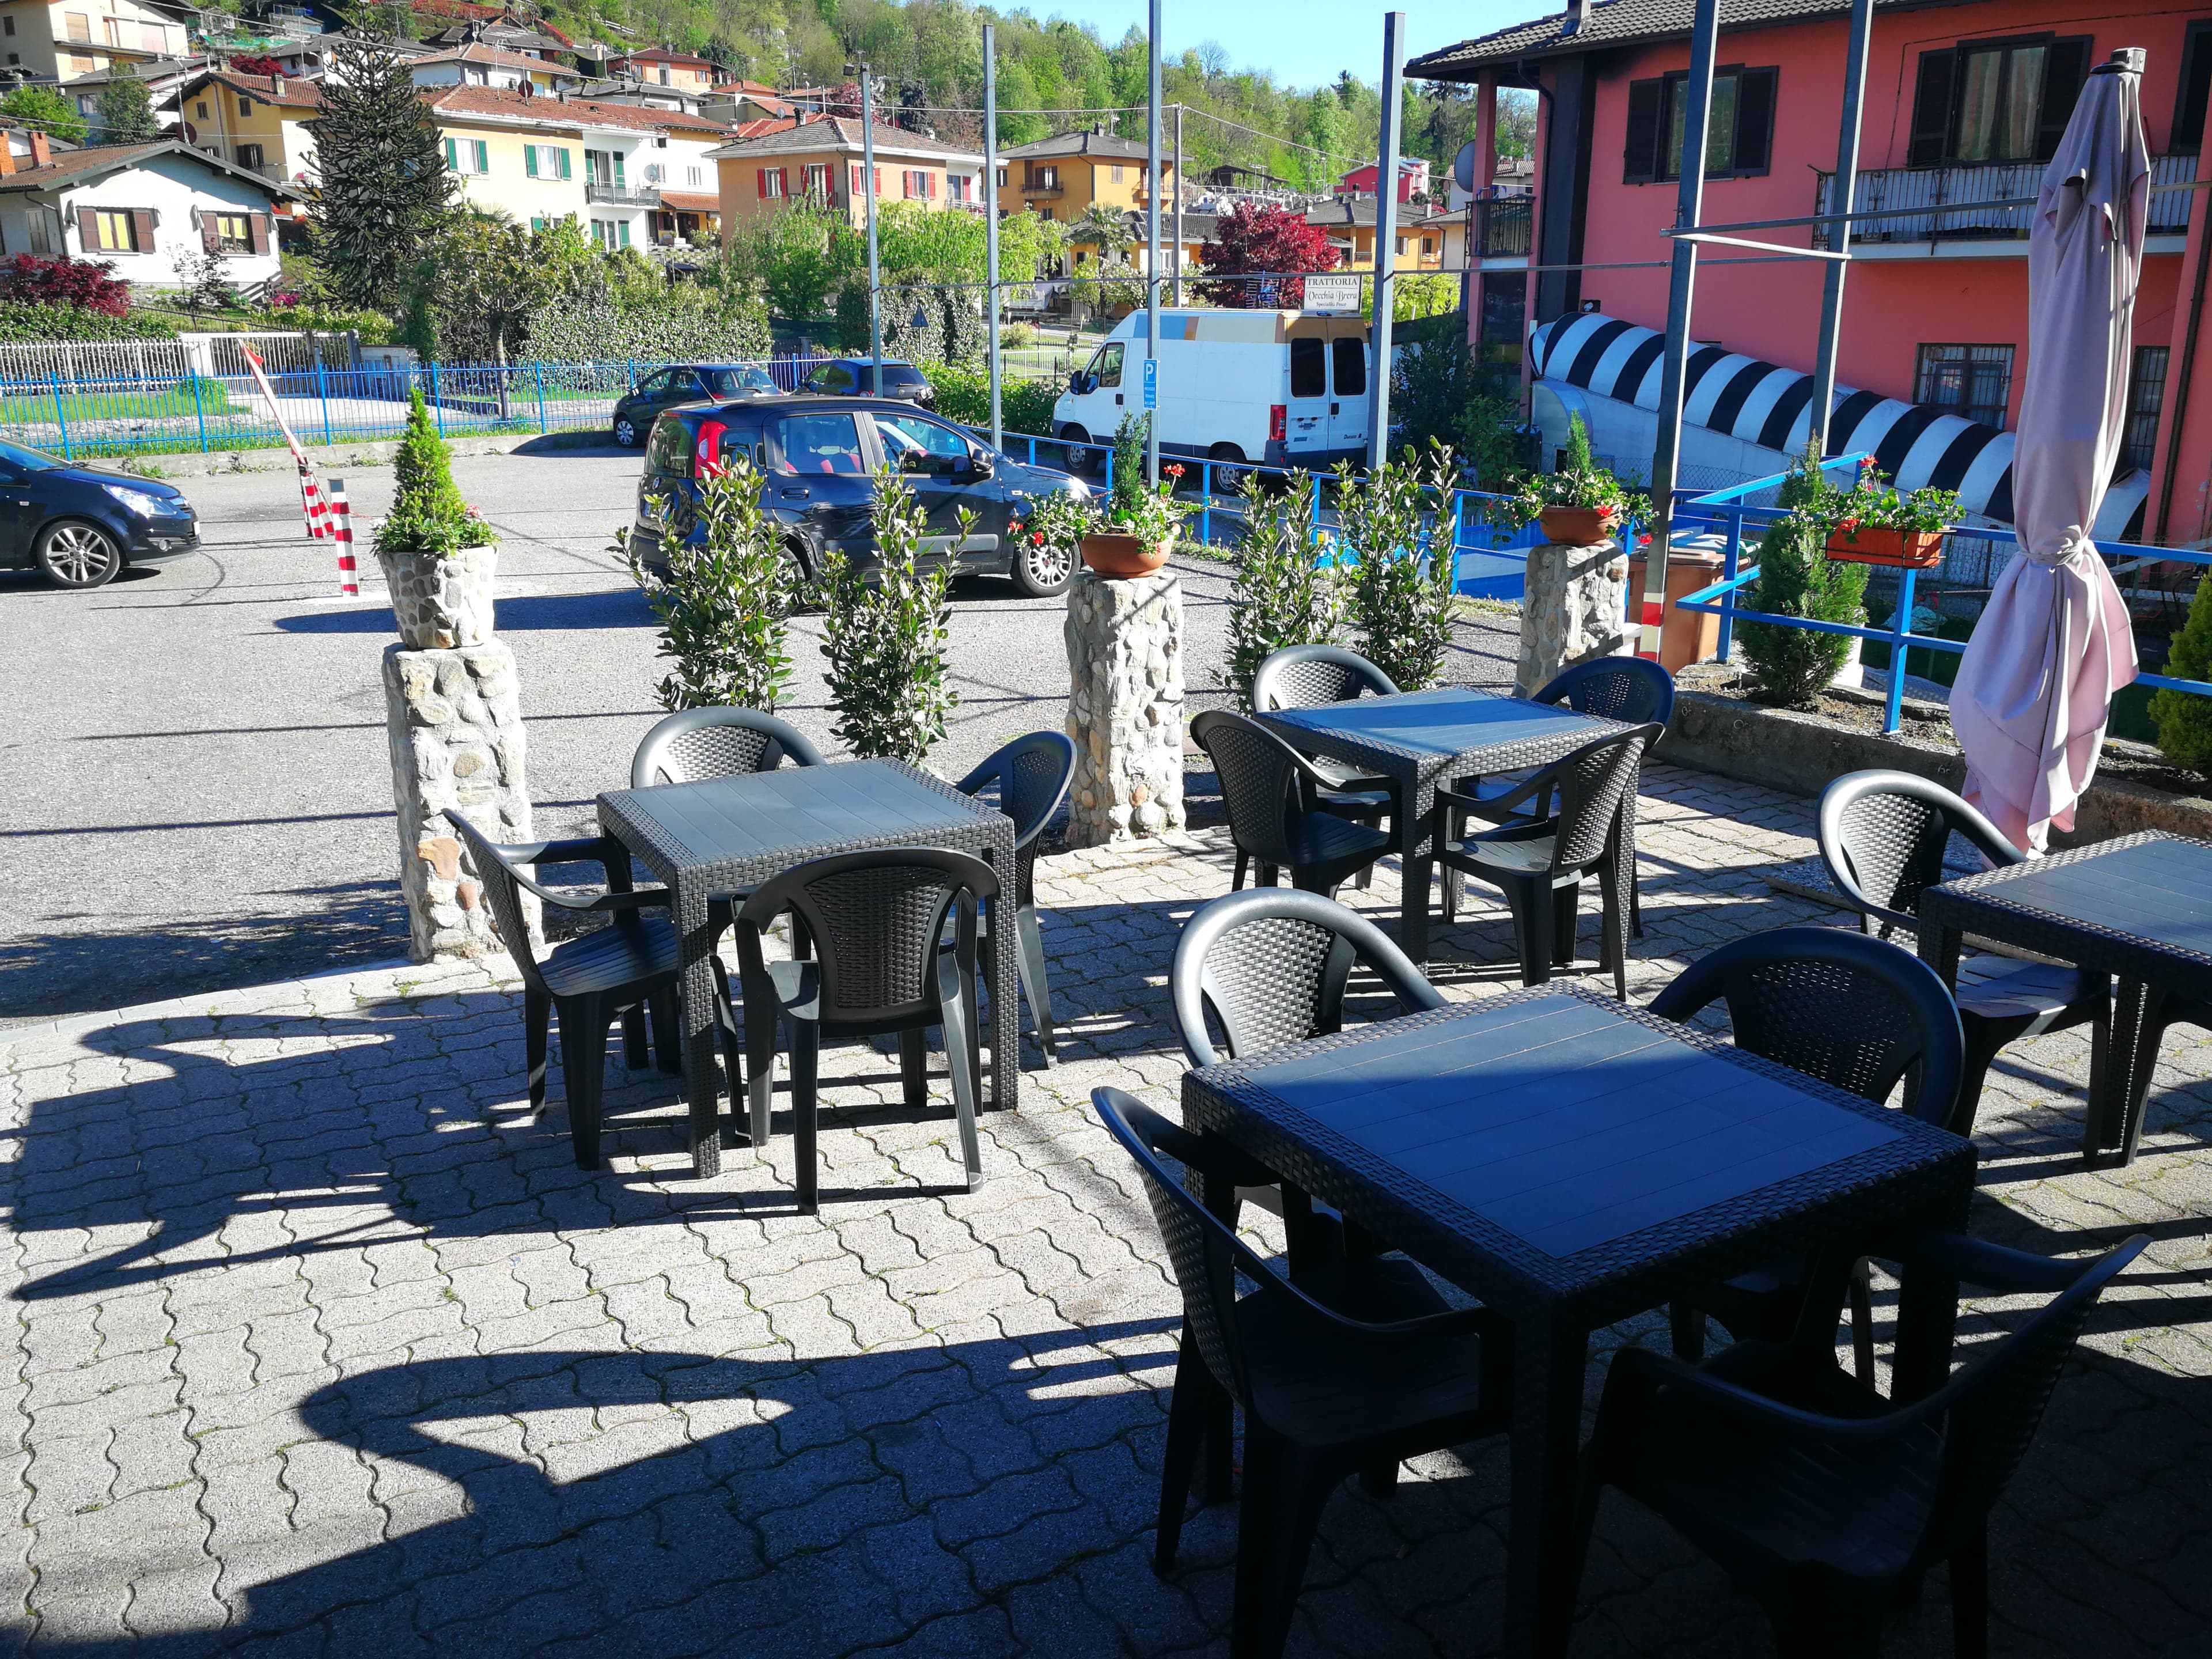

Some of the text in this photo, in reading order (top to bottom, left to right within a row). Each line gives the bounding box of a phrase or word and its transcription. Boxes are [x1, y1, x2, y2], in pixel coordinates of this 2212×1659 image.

[1307, 278, 1357, 286] TRATTORIA
[1306, 290, 1357, 301] Vecchia Brera
[1146, 363, 1154, 381] P
